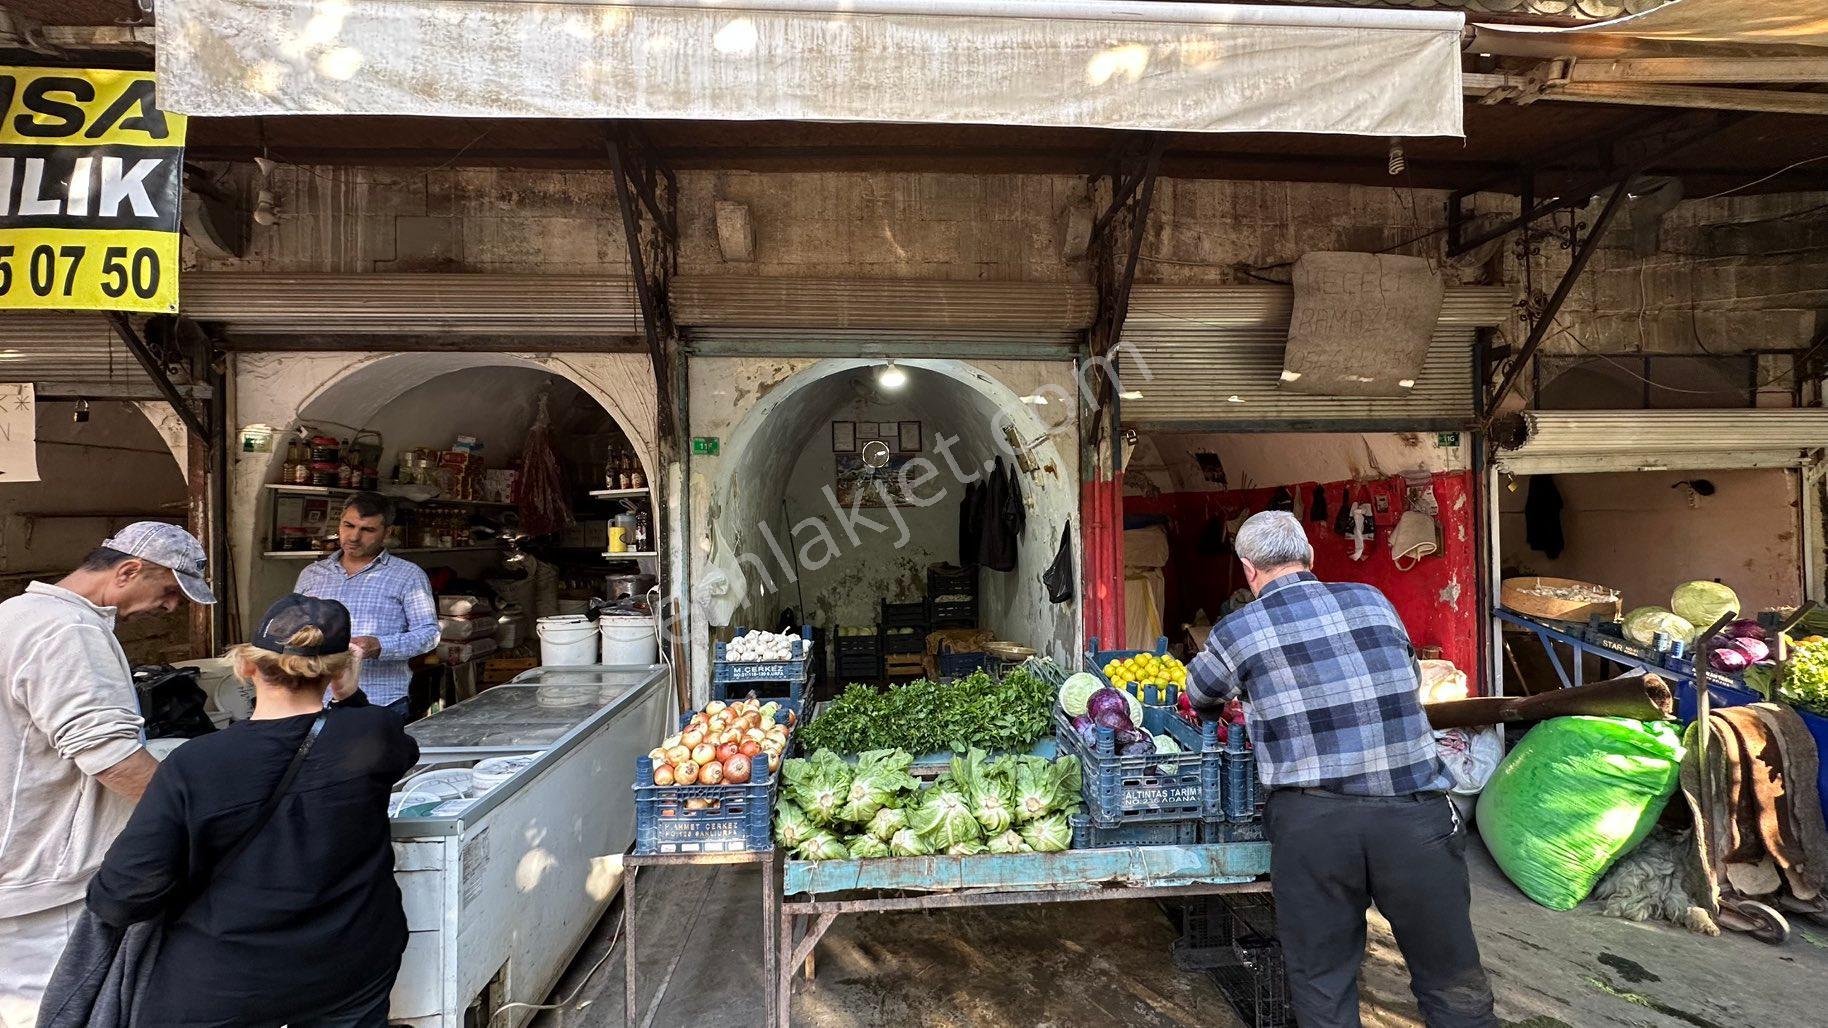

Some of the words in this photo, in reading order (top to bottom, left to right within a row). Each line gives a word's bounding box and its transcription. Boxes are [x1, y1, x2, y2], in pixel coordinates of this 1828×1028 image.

[30, 244, 86, 297] 07
[100, 246, 160, 299] 50
[1603, 639, 1623, 652] STAR
[674, 823, 700, 831] AHMET
